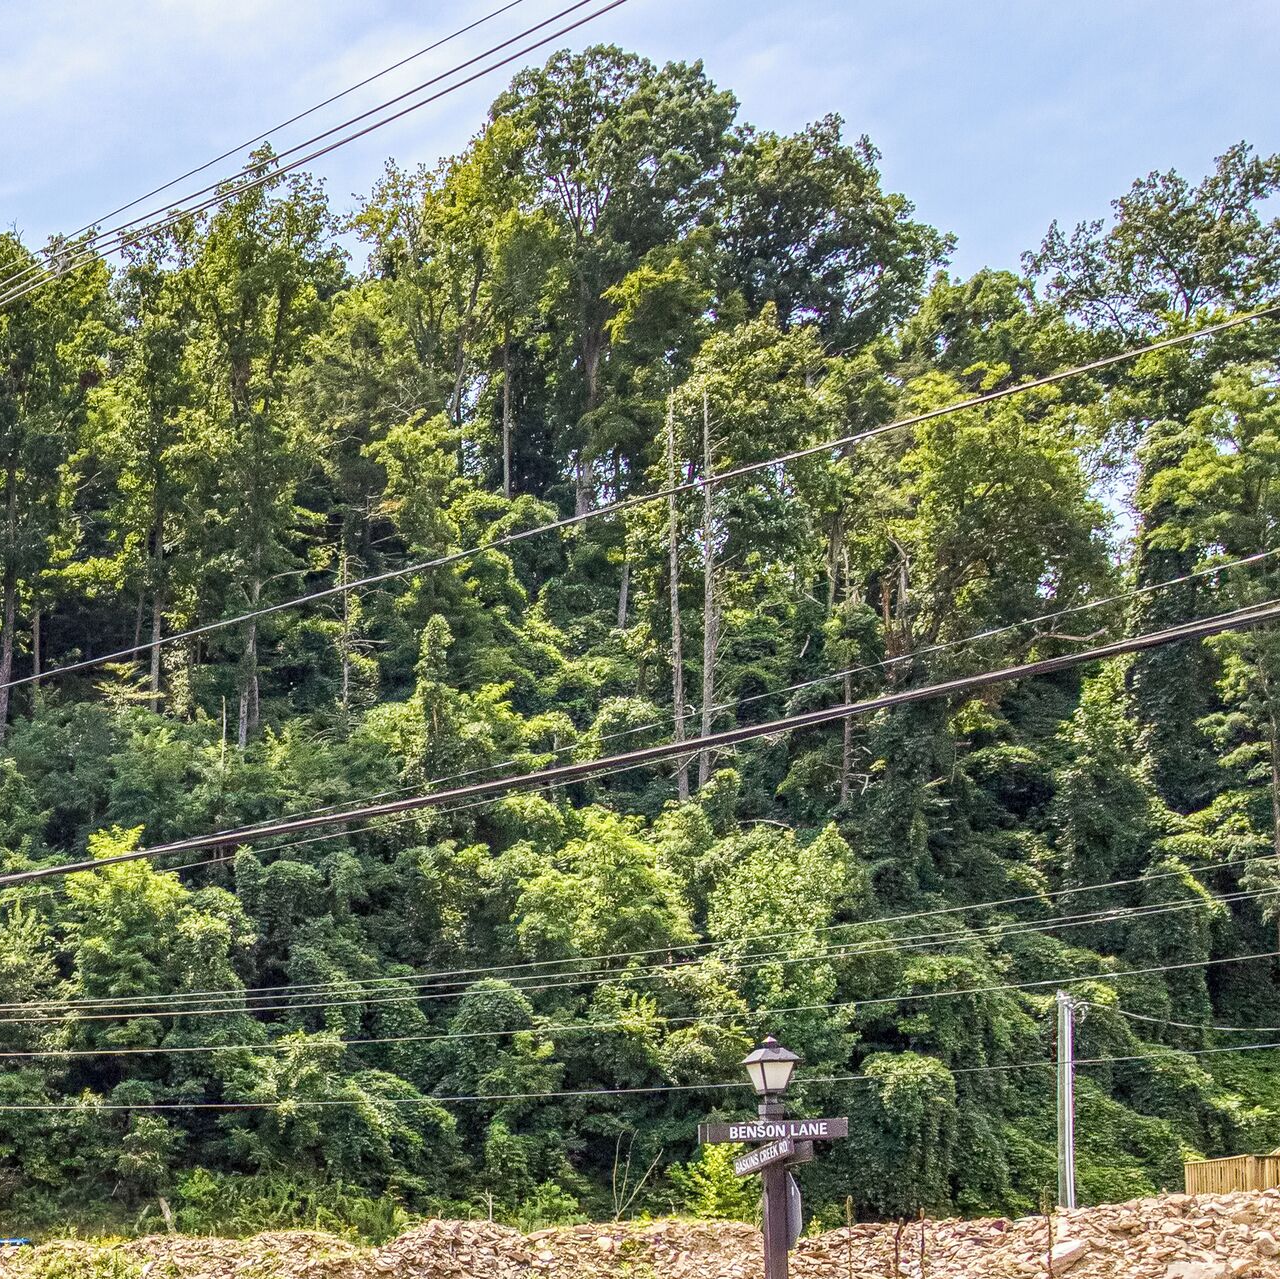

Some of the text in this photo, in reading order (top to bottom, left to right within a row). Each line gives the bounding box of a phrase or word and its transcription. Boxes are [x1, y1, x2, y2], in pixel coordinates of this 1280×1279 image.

[729, 1122, 828, 1139] BENSON LANE
[735, 1153, 760, 1175] BASKINS
[759, 1145, 779, 1163] CREEK
